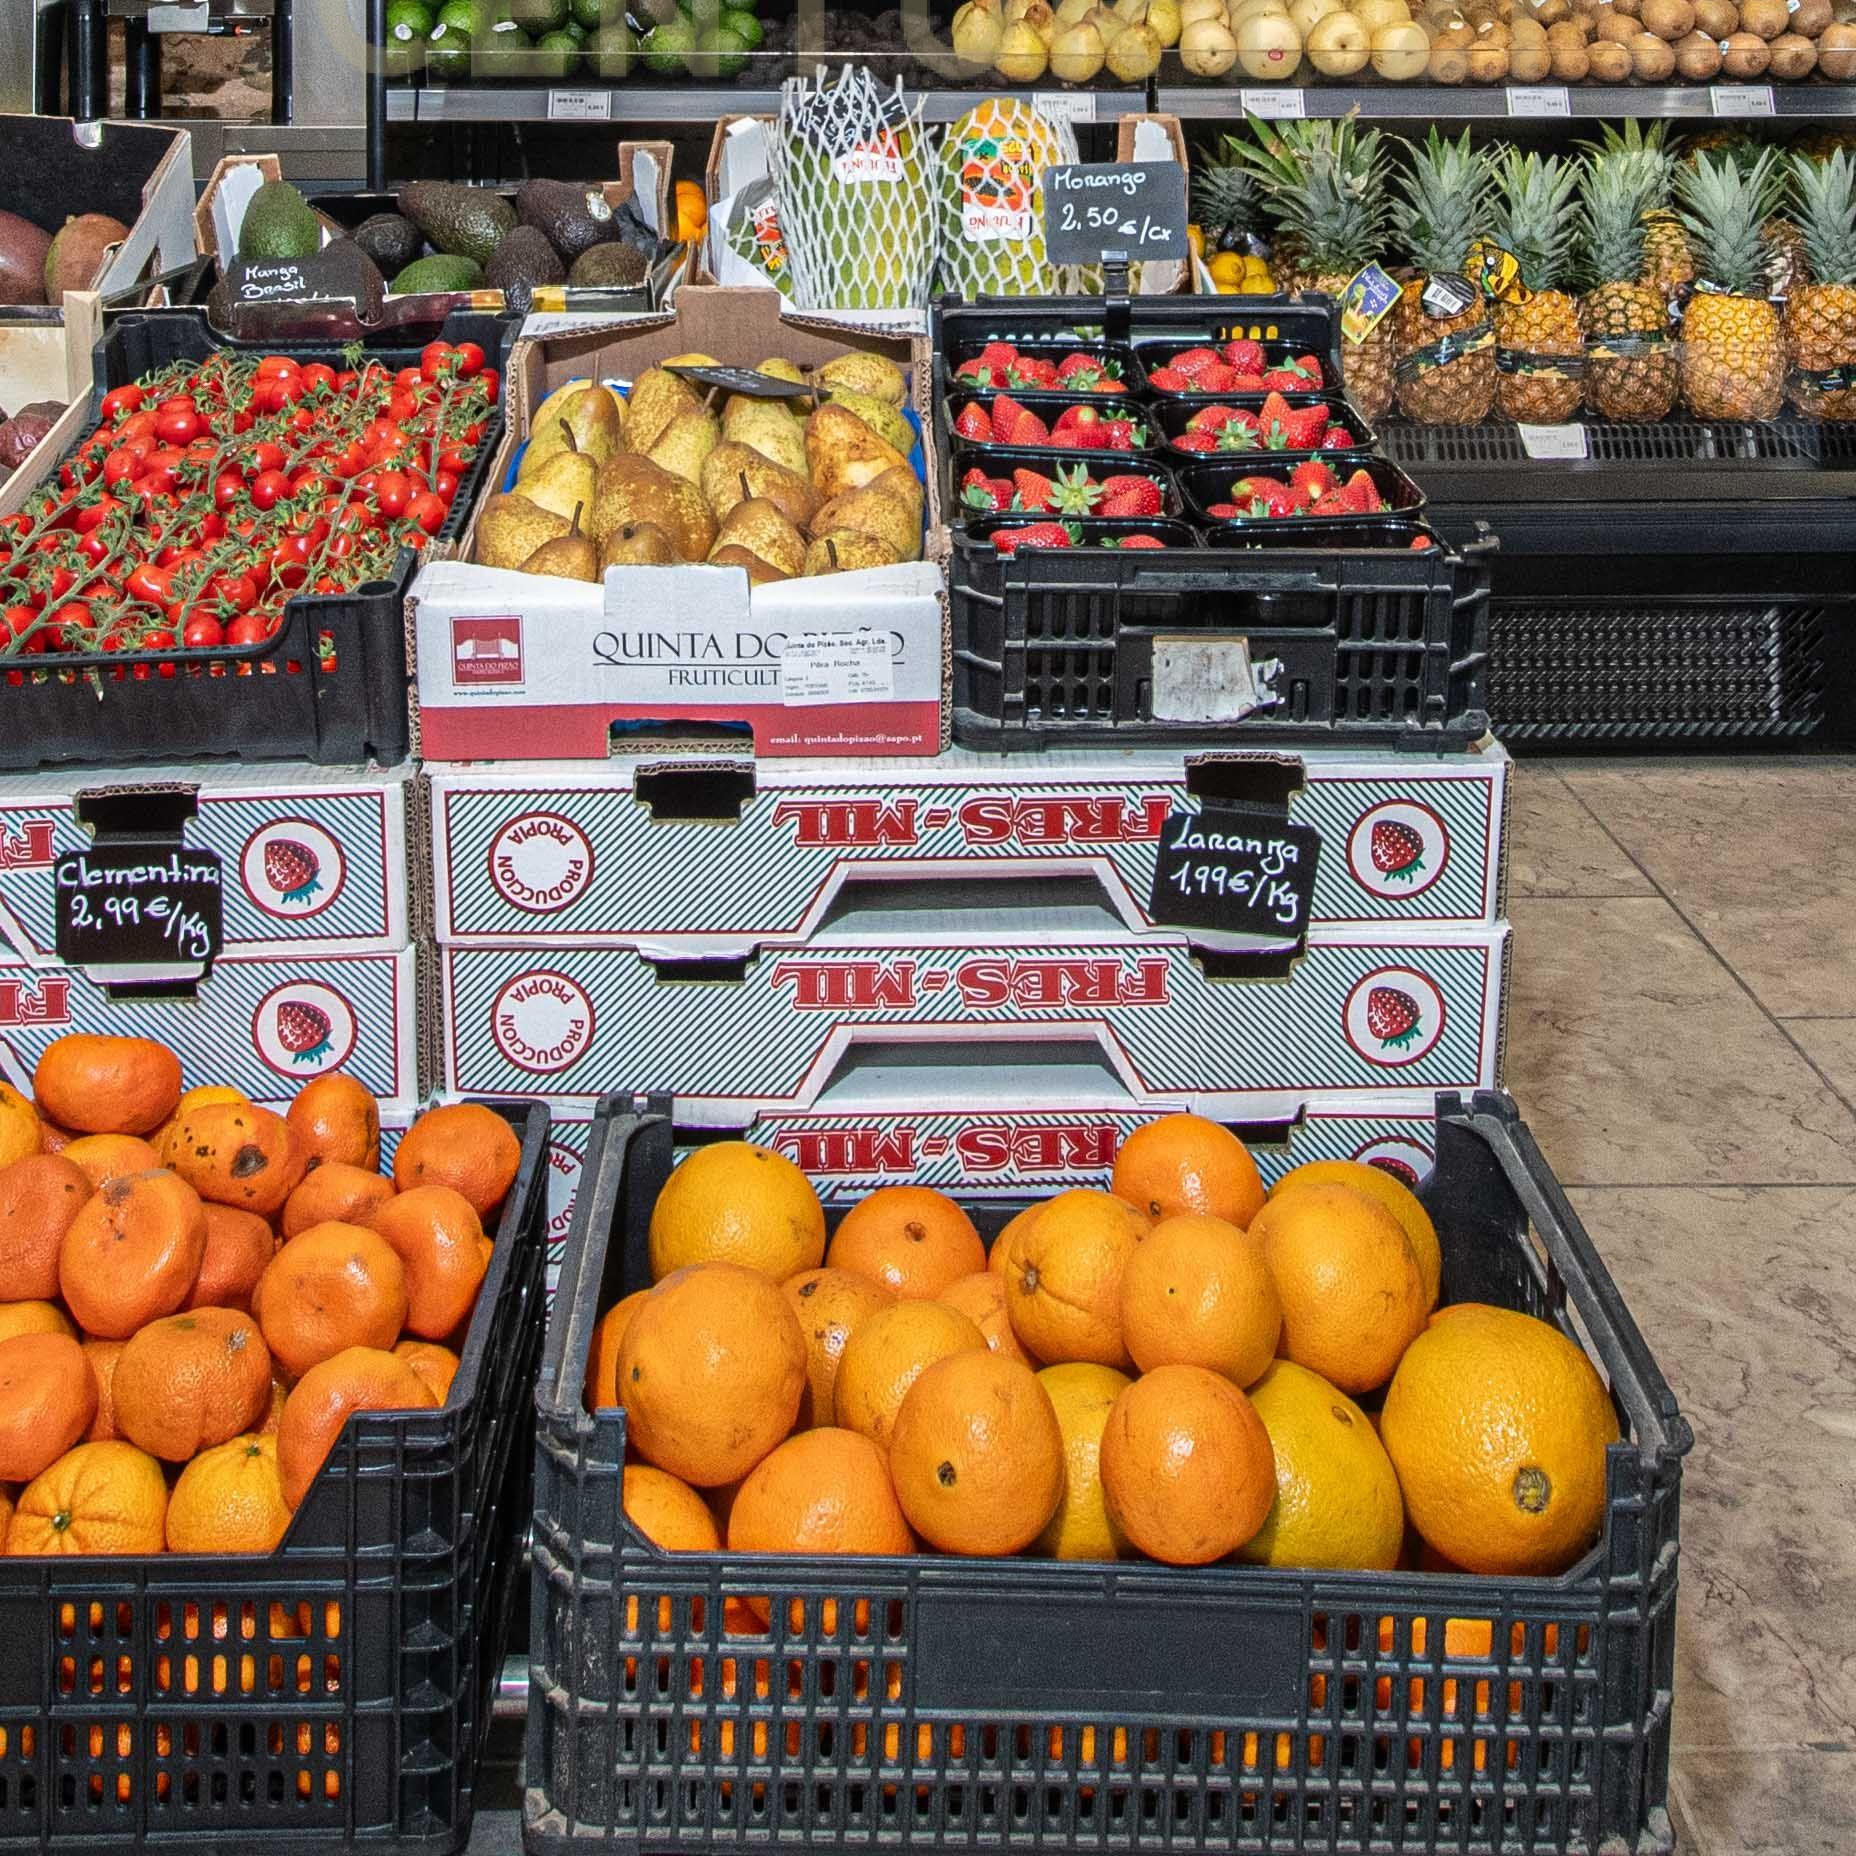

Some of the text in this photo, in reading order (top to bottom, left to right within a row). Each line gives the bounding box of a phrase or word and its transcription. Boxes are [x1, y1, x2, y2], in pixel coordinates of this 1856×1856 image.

[1055, 167, 1146, 195] Morango
[245, 265, 298, 281] Manga
[240, 276, 305, 298] Brasil
[592, 630, 741, 661] QUINTA
[668, 668, 781, 687] FRUTICULT
[770, 733, 801, 744] email:
[507, 821, 575, 846] PROPIA
[57, 853, 220, 888] Clementina
[497, 855, 584, 905] PRODUCCION
[510, 979, 576, 1006] PROPIA
[500, 1013, 585, 1065] PRODUCCION
